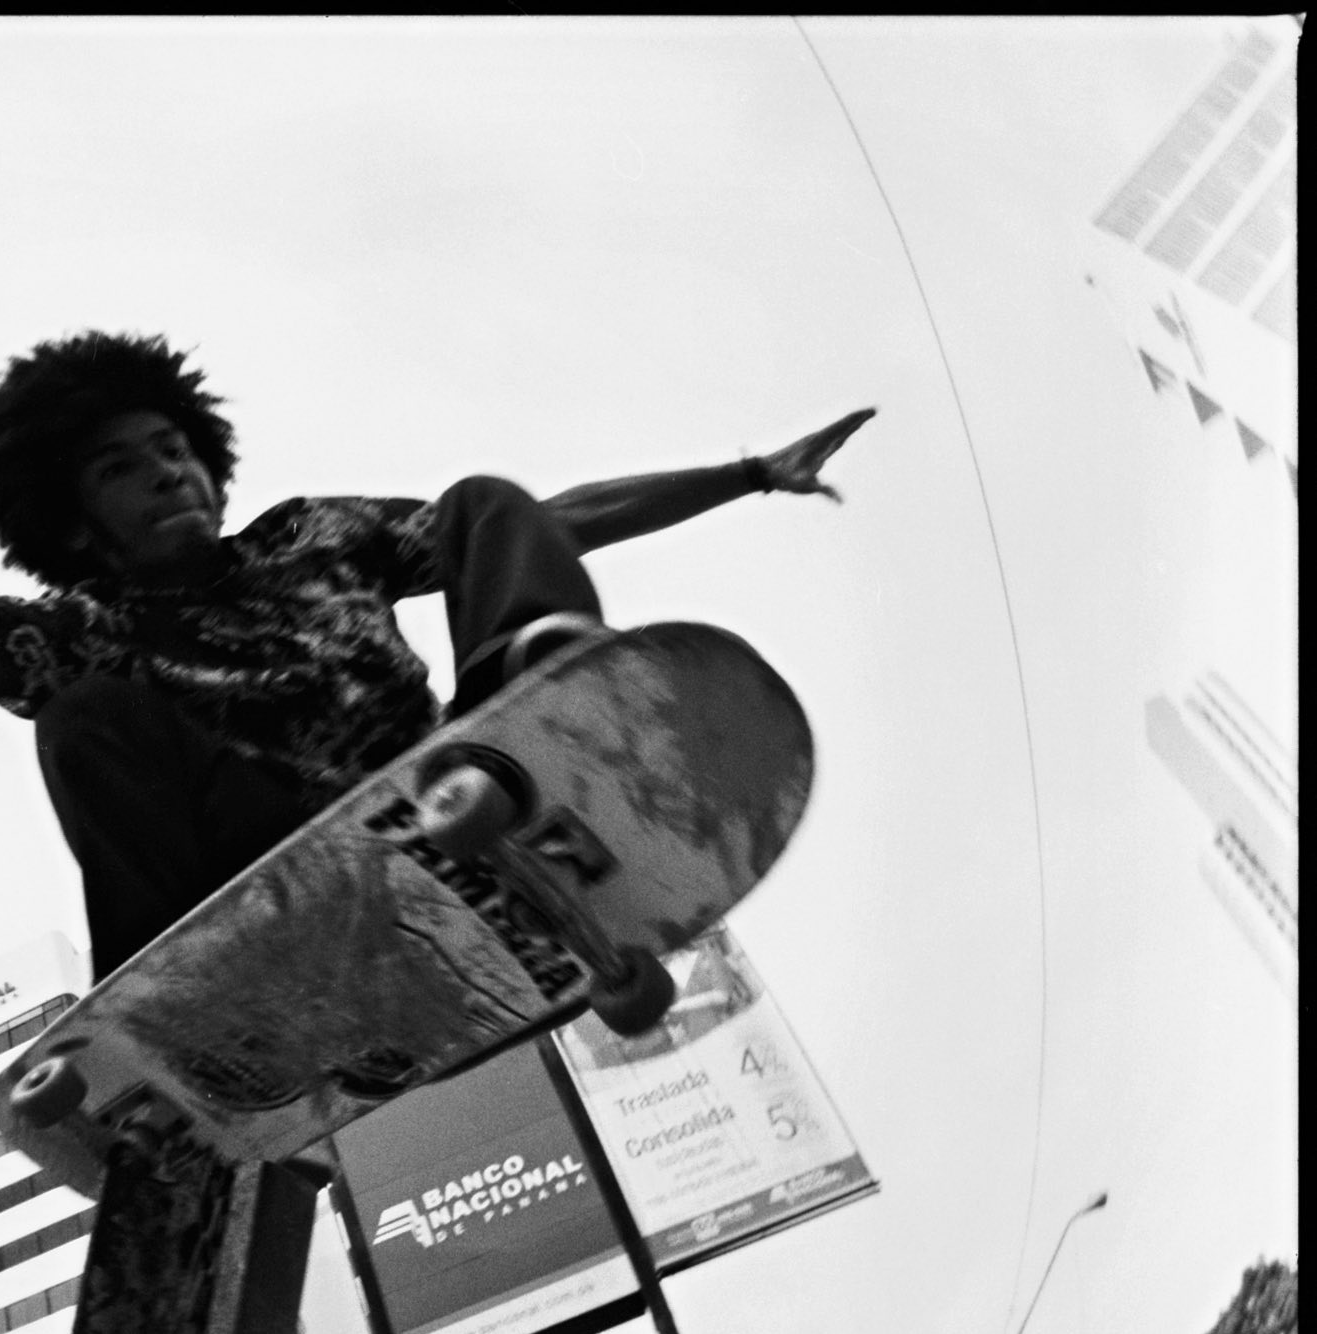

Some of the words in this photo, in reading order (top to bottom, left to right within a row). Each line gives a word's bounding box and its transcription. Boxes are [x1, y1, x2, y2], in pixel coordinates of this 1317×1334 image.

[615, 1068, 710, 1118] Traslada
[625, 1104, 736, 1160] Consolida
[422, 1154, 525, 1210] BANCO
[428, 1154, 584, 1230] NACIONAL
[435, 1221, 467, 1244] DE
